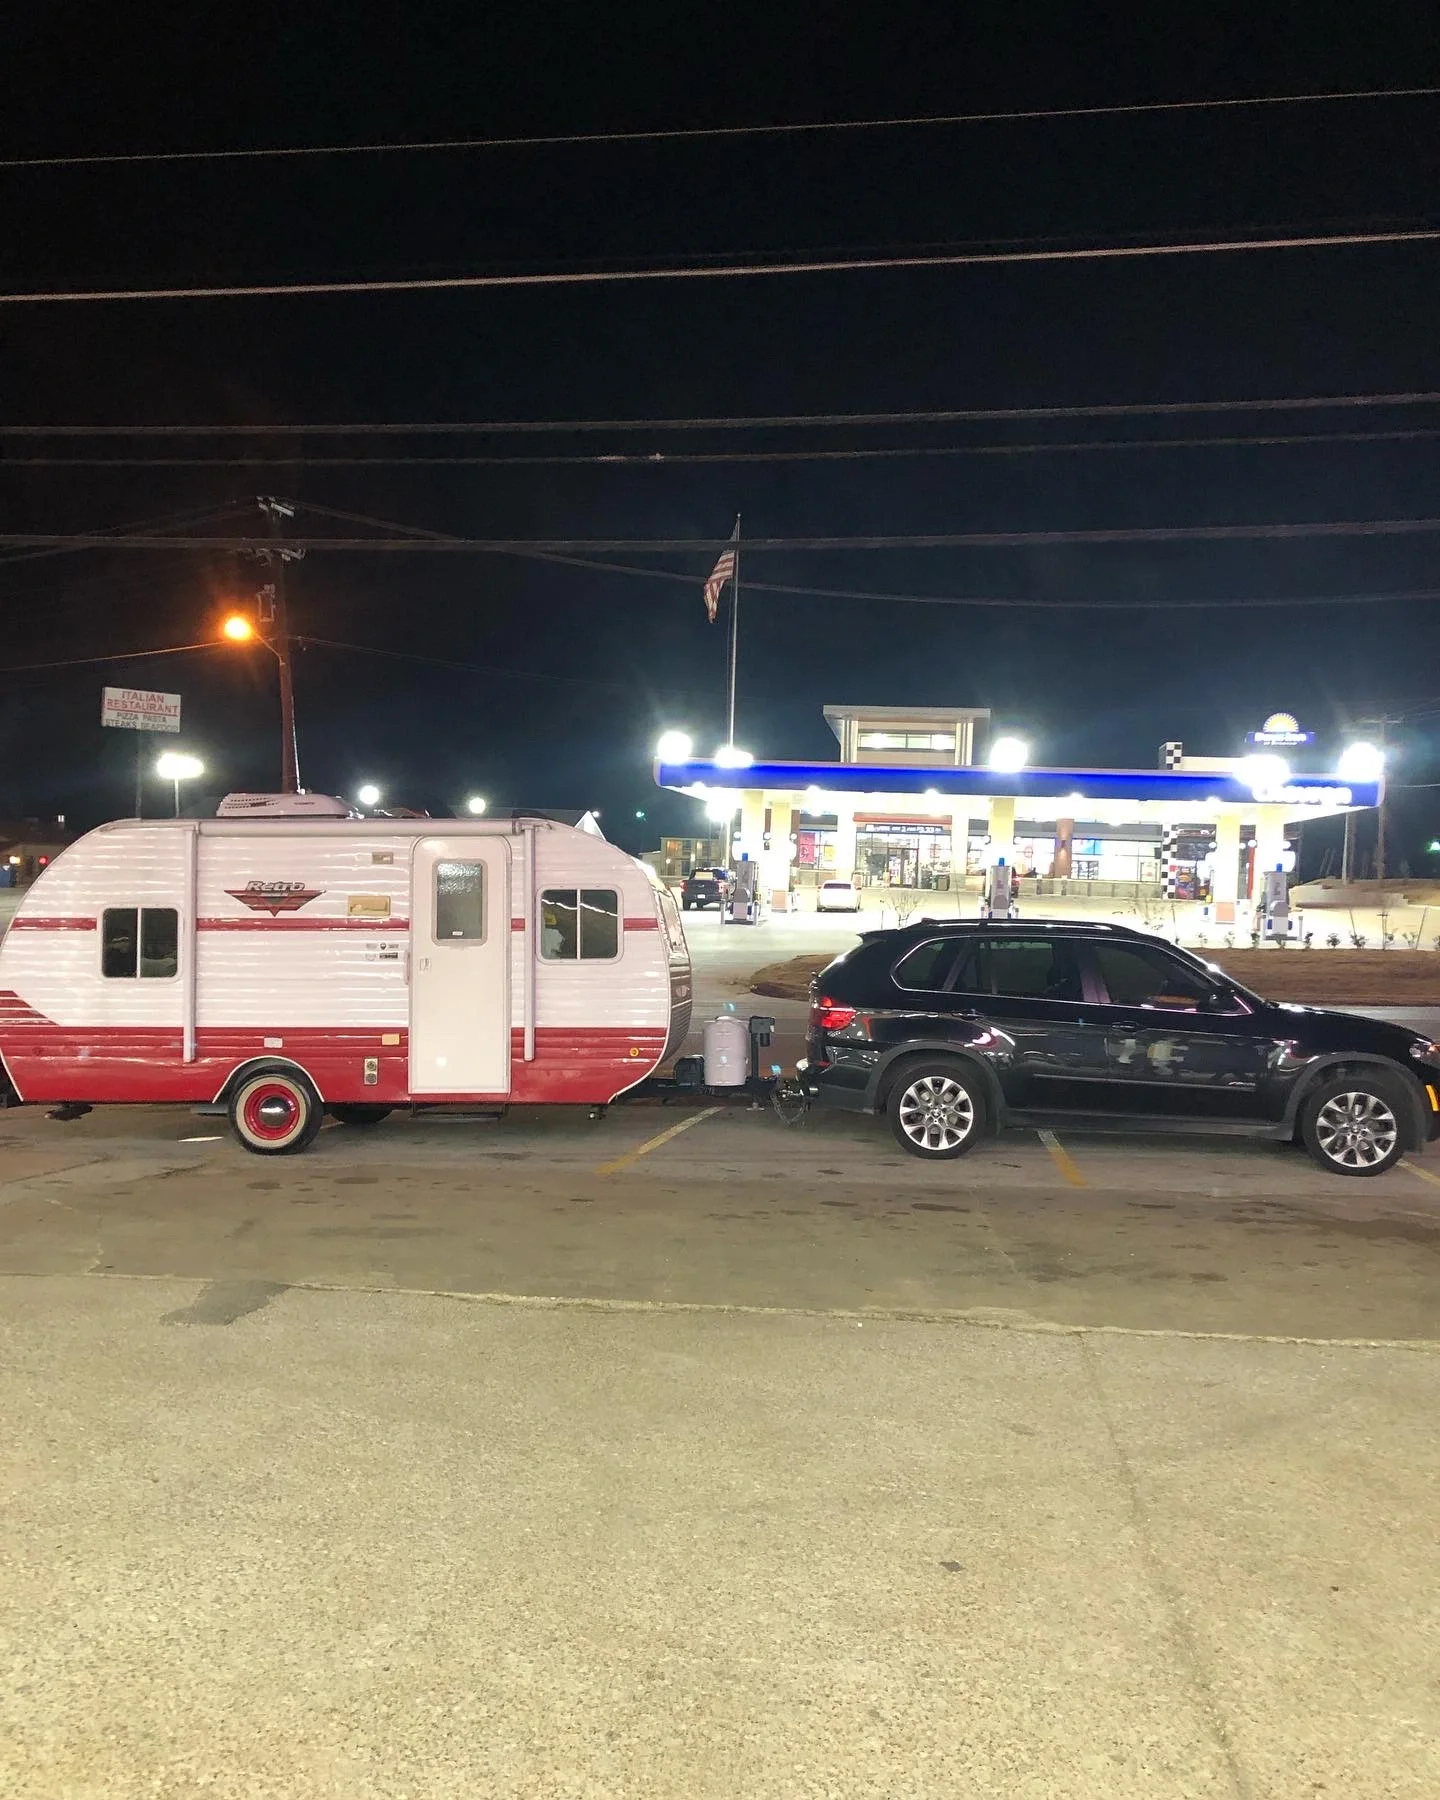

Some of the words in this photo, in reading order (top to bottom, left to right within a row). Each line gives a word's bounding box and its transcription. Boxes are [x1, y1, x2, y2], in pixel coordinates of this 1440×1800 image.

[121, 691, 164, 703] ITALIAN
[107, 699, 178, 714] RESTAURANT
[116, 711, 139, 721] PIZZA
[245, 880, 305, 892] Retro
